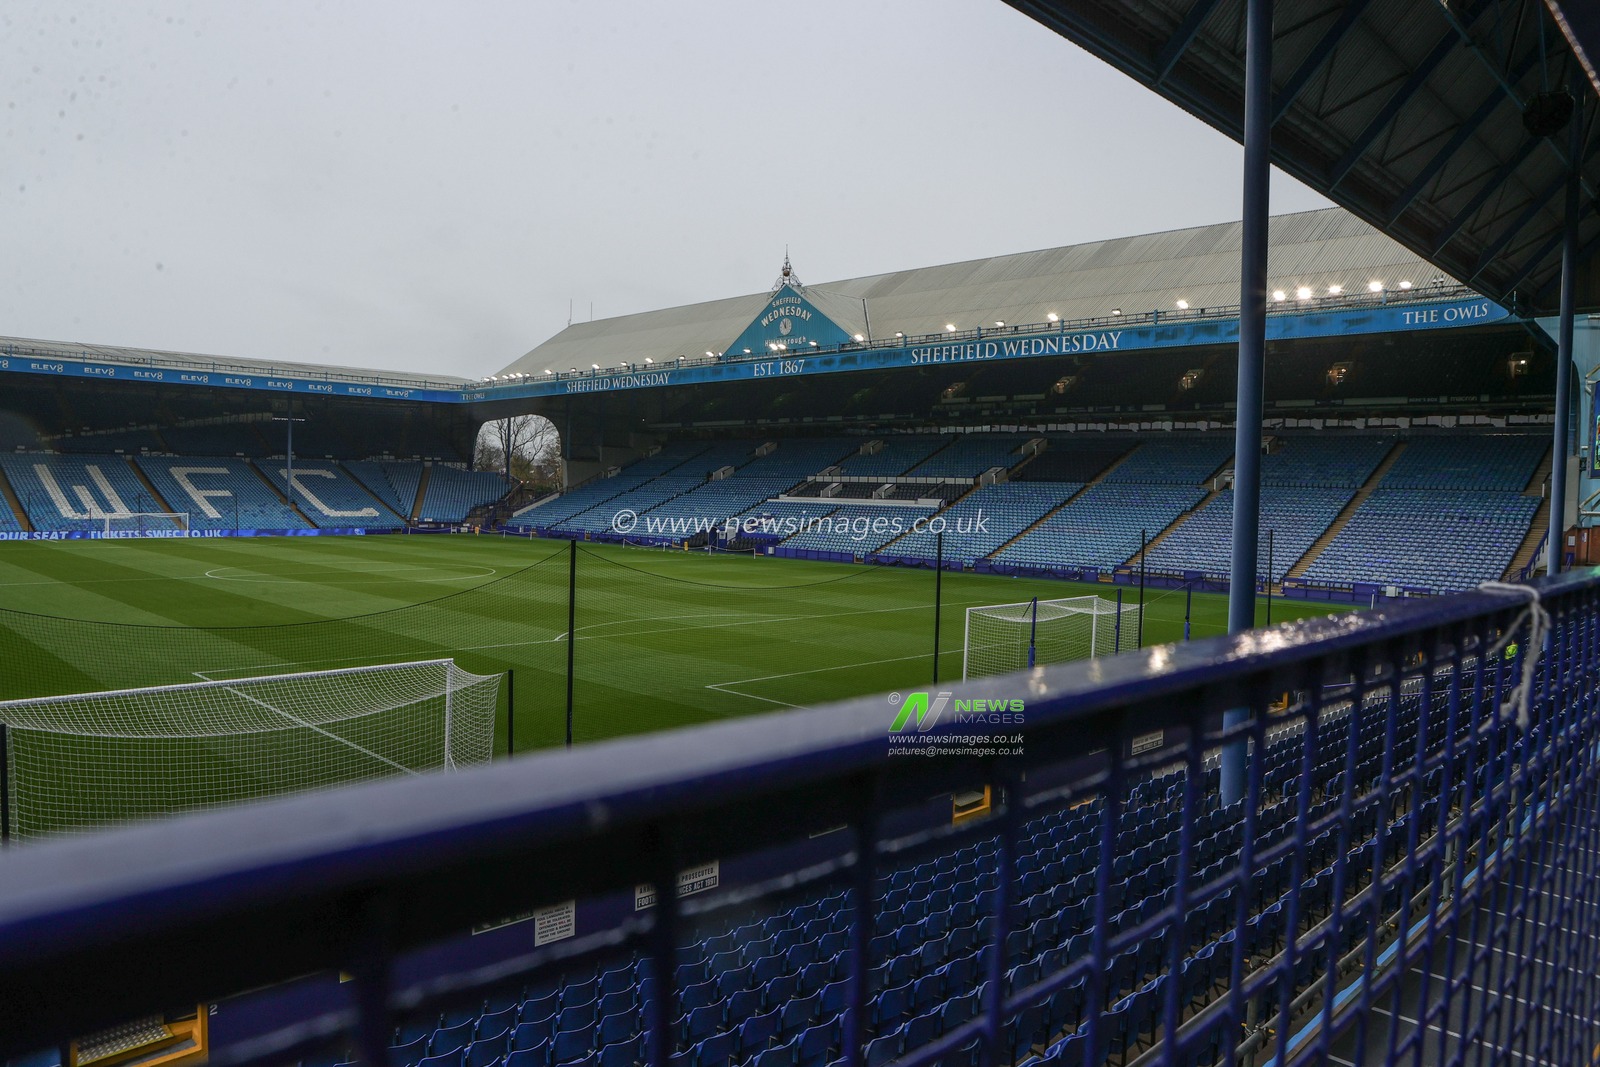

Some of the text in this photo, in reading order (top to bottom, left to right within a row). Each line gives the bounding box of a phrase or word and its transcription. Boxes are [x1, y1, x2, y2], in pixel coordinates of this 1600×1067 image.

[772, 296, 802, 308] SHEFFIELD
[761, 306, 813, 327] WEDNESDAY
[1402, 303, 1489, 325] THE OWLS
[911, 331, 1123, 364] SHEFFIELD WEDNESDAY
[31, 363, 64, 373] ELEV8
[84, 367, 115, 377] ELEV8
[753, 360, 805, 378] EST. 1867
[134, 371, 163, 380] ELEV8
[181, 375, 209, 383] ELEV8
[225, 378, 252, 387] ELEV8
[267, 381, 293, 390] ELEV8
[566, 372, 671, 393] SHEFFIELD WEDNESDAY
[308, 384, 333, 393] ELEV8
[348, 387, 372, 396] ELEV8
[386, 389, 409, 398] ELEV8
[33, 530, 69, 540] SEAT
[693, 880, 704, 891] ACT
[705, 876, 717, 887] 1991
[209, 1004, 218, 1016] 2
